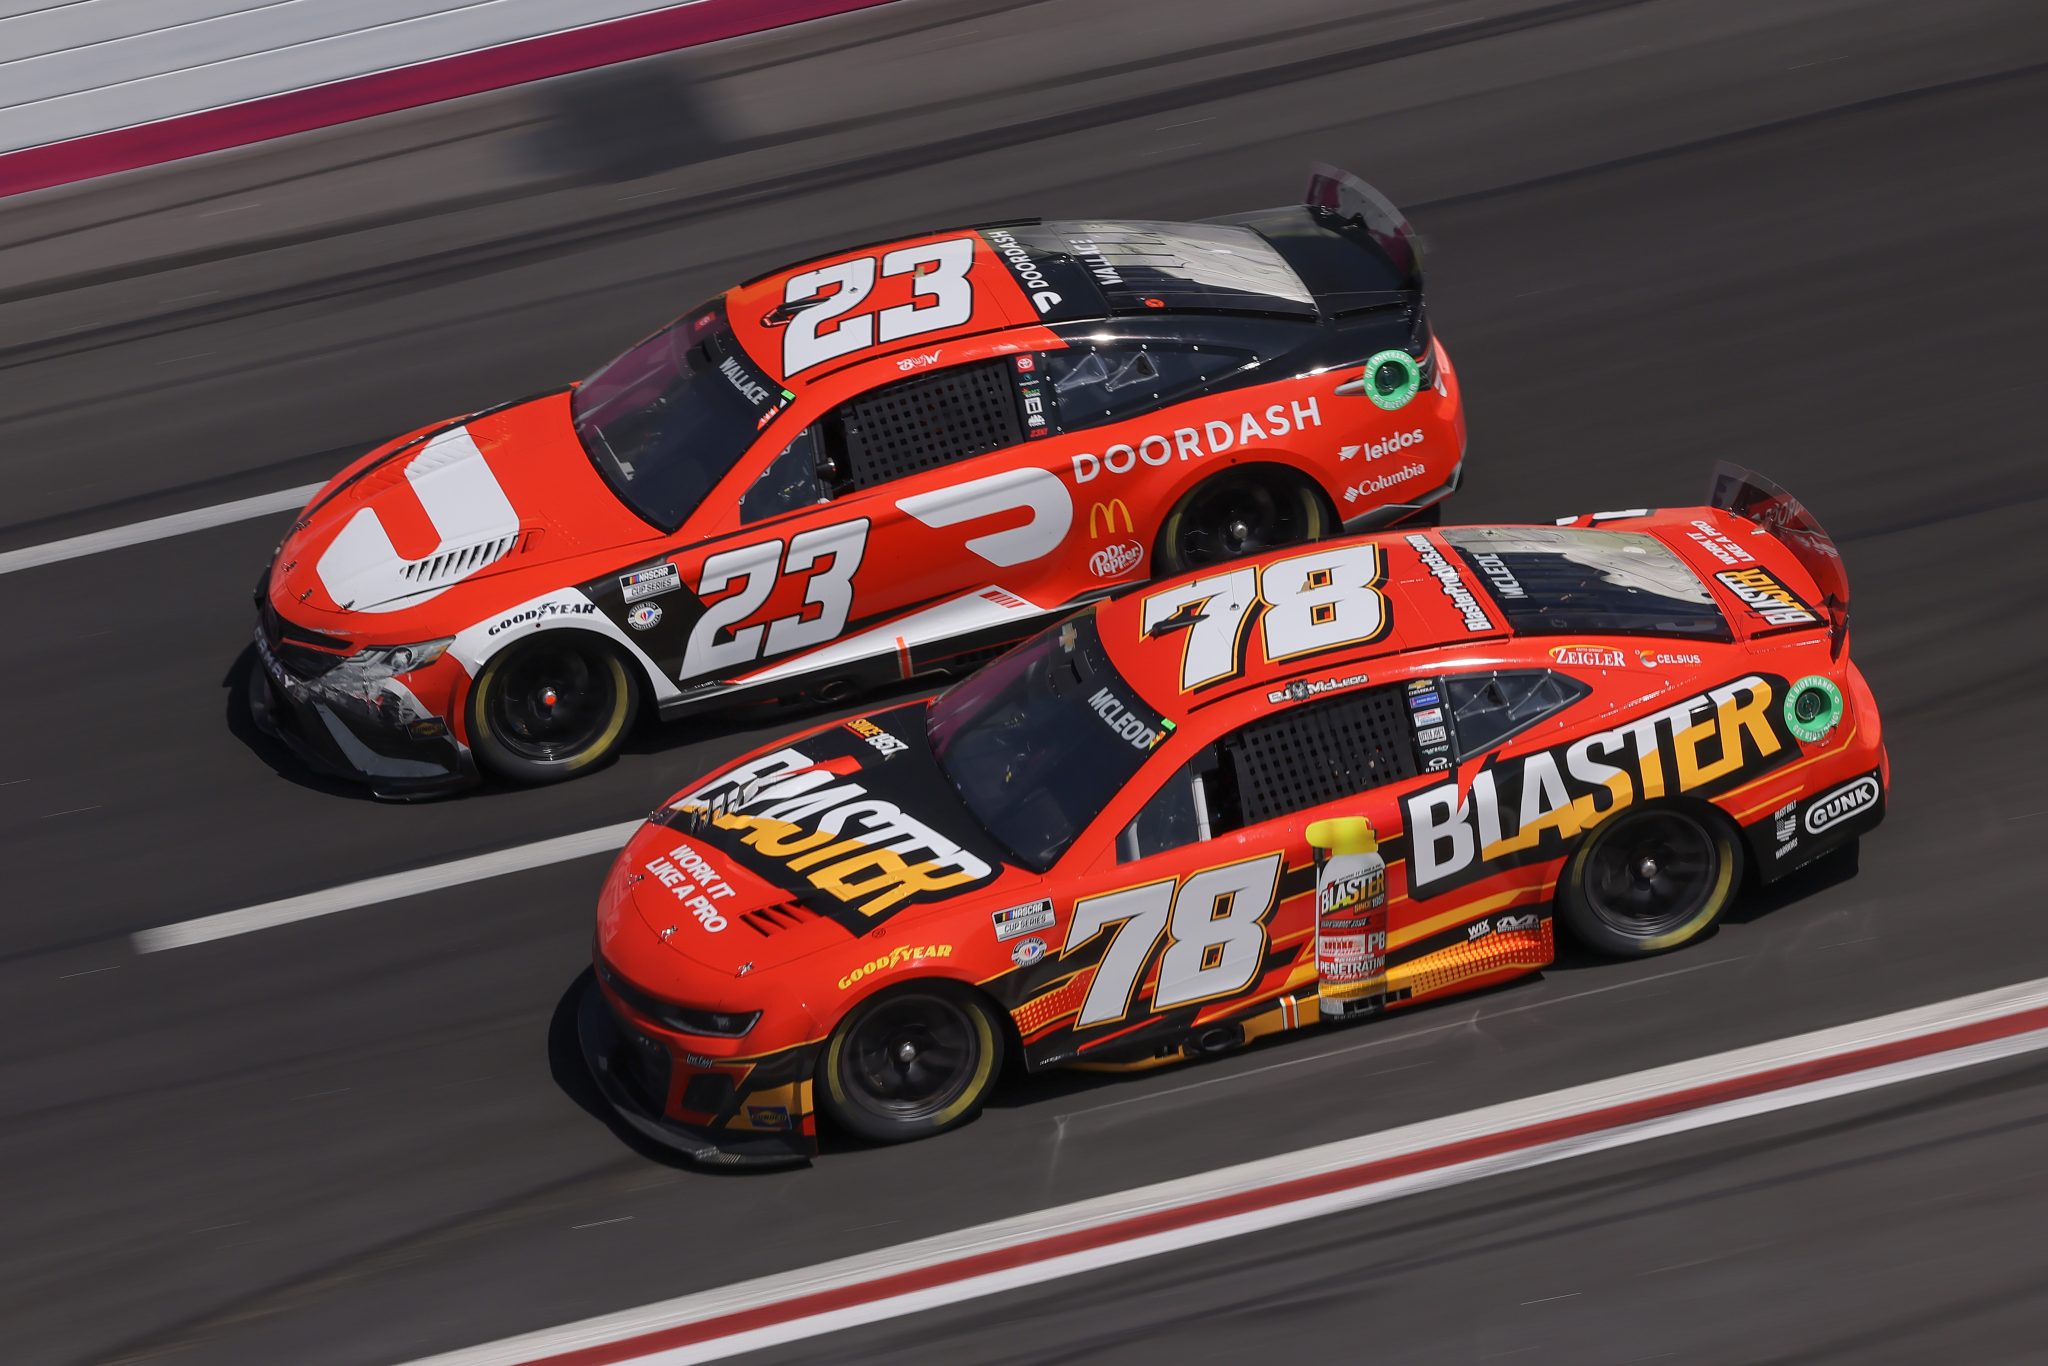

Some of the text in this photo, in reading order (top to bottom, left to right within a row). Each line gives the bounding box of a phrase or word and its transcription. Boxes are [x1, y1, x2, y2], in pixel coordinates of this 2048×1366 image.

[988, 230, 1050, 289] DOORDASH
[781, 237, 975, 380] 23
[719, 355, 770, 406] WALLACE
[1071, 395, 1323, 484] DOORDASH
[1363, 428, 1425, 462] leidos
[1358, 462, 1426, 496] Columbia
[1094, 546, 1140, 577] Pepper
[1105, 543, 1126, 560] Dr
[1686, 532, 1739, 566] WORK IT
[1690, 520, 1756, 563] LIKE A PRO
[638, 567, 669, 583] NASCAR
[1715, 567, 1817, 626] BLASTER
[488, 600, 597, 637] GOODYEAR
[679, 516, 871, 682] 23
[1138, 541, 1395, 696] 78
[1555, 648, 1626, 667] ZEIGLER
[1656, 654, 1702, 665] CELSIUS
[1087, 686, 1157, 750] MCLEOD
[865, 733, 909, 755] 1957
[1407, 675, 1782, 888] BLASTER
[1813, 784, 1872, 826] GUNK
[669, 748, 992, 918] BLASTER
[645, 856, 729, 933] LIKE A PRO
[669, 844, 737, 900] WORK IT
[1321, 869, 1385, 915] BLASTER
[1012, 902, 1043, 920] NASCAR
[1467, 919, 1489, 937] WIX
[1058, 849, 1286, 1031] 78
[838, 944, 953, 991] GOODYEAR
